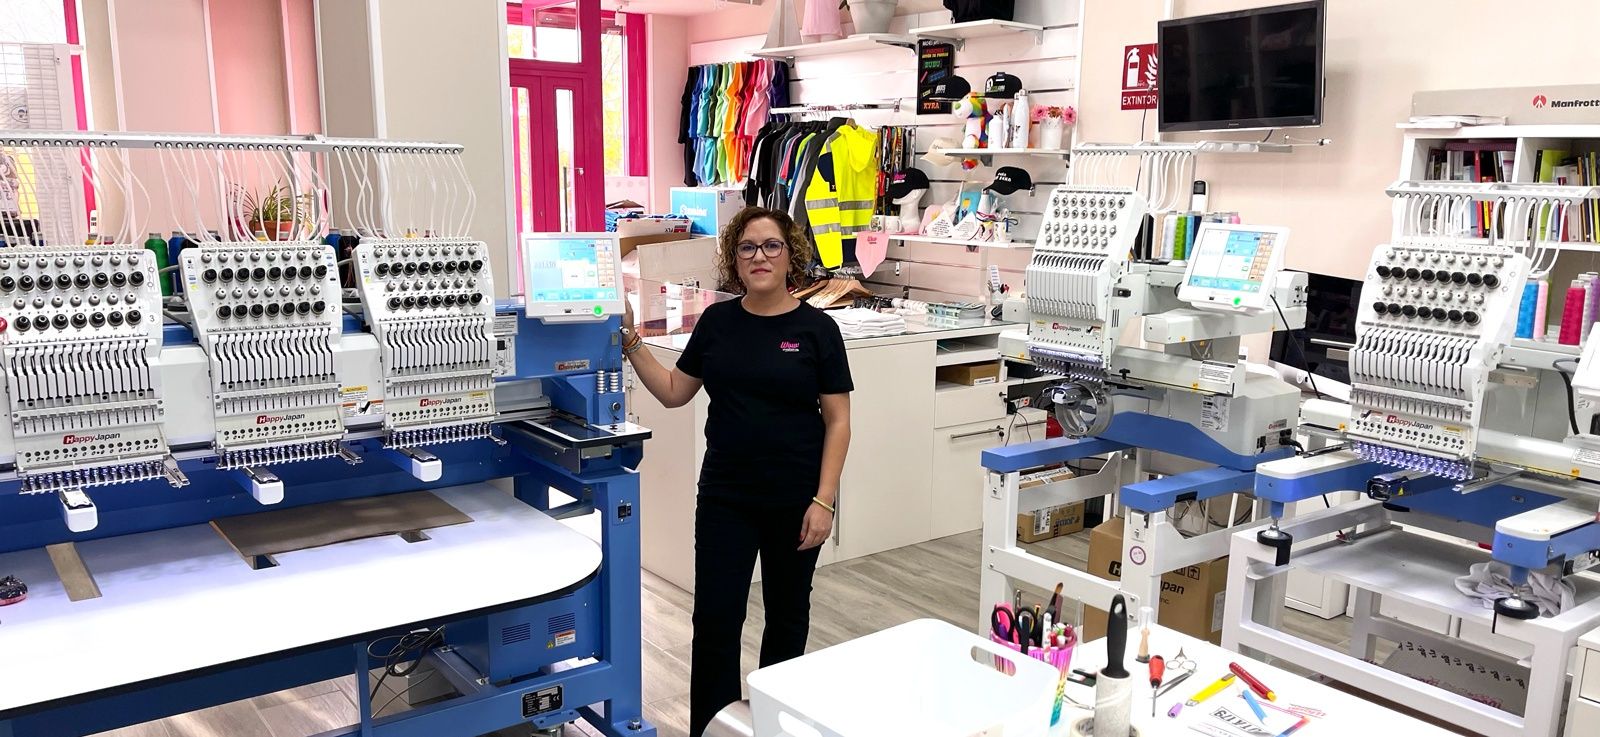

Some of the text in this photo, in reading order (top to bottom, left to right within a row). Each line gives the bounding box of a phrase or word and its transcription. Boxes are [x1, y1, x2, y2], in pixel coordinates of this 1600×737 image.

[1122, 95, 1157, 106] EXTINTOR
[420, 397, 462, 407] HappyJapan
[256, 413, 305, 425] HappyJapan
[1387, 414, 1434, 430] HappyJapan
[63, 432, 120, 445] HappyJapan
